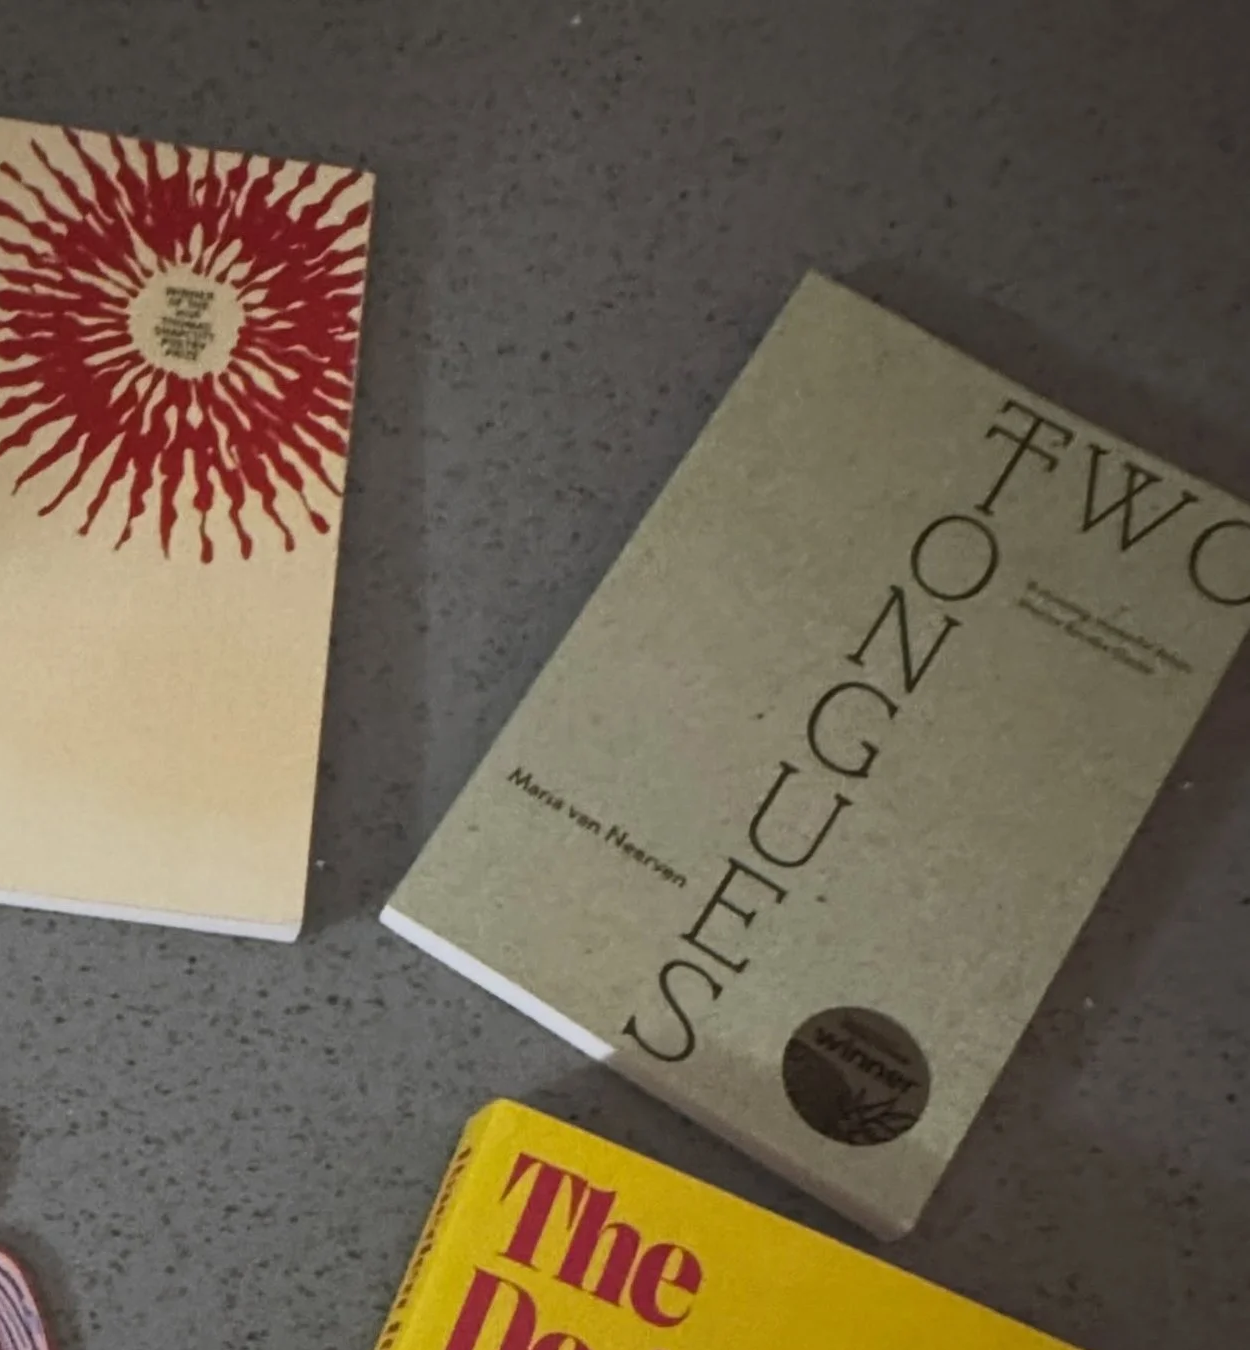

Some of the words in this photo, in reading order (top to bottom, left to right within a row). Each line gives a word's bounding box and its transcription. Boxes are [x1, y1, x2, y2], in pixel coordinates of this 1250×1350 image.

[973, 399, 1250, 608] TWO
[507, 766, 563, 811] Maria
[568, 804, 602, 835] van
[604, 823, 688, 889] Neerven
[621, 399, 1076, 1064] TONGUES
[495, 1150, 705, 1329] The
